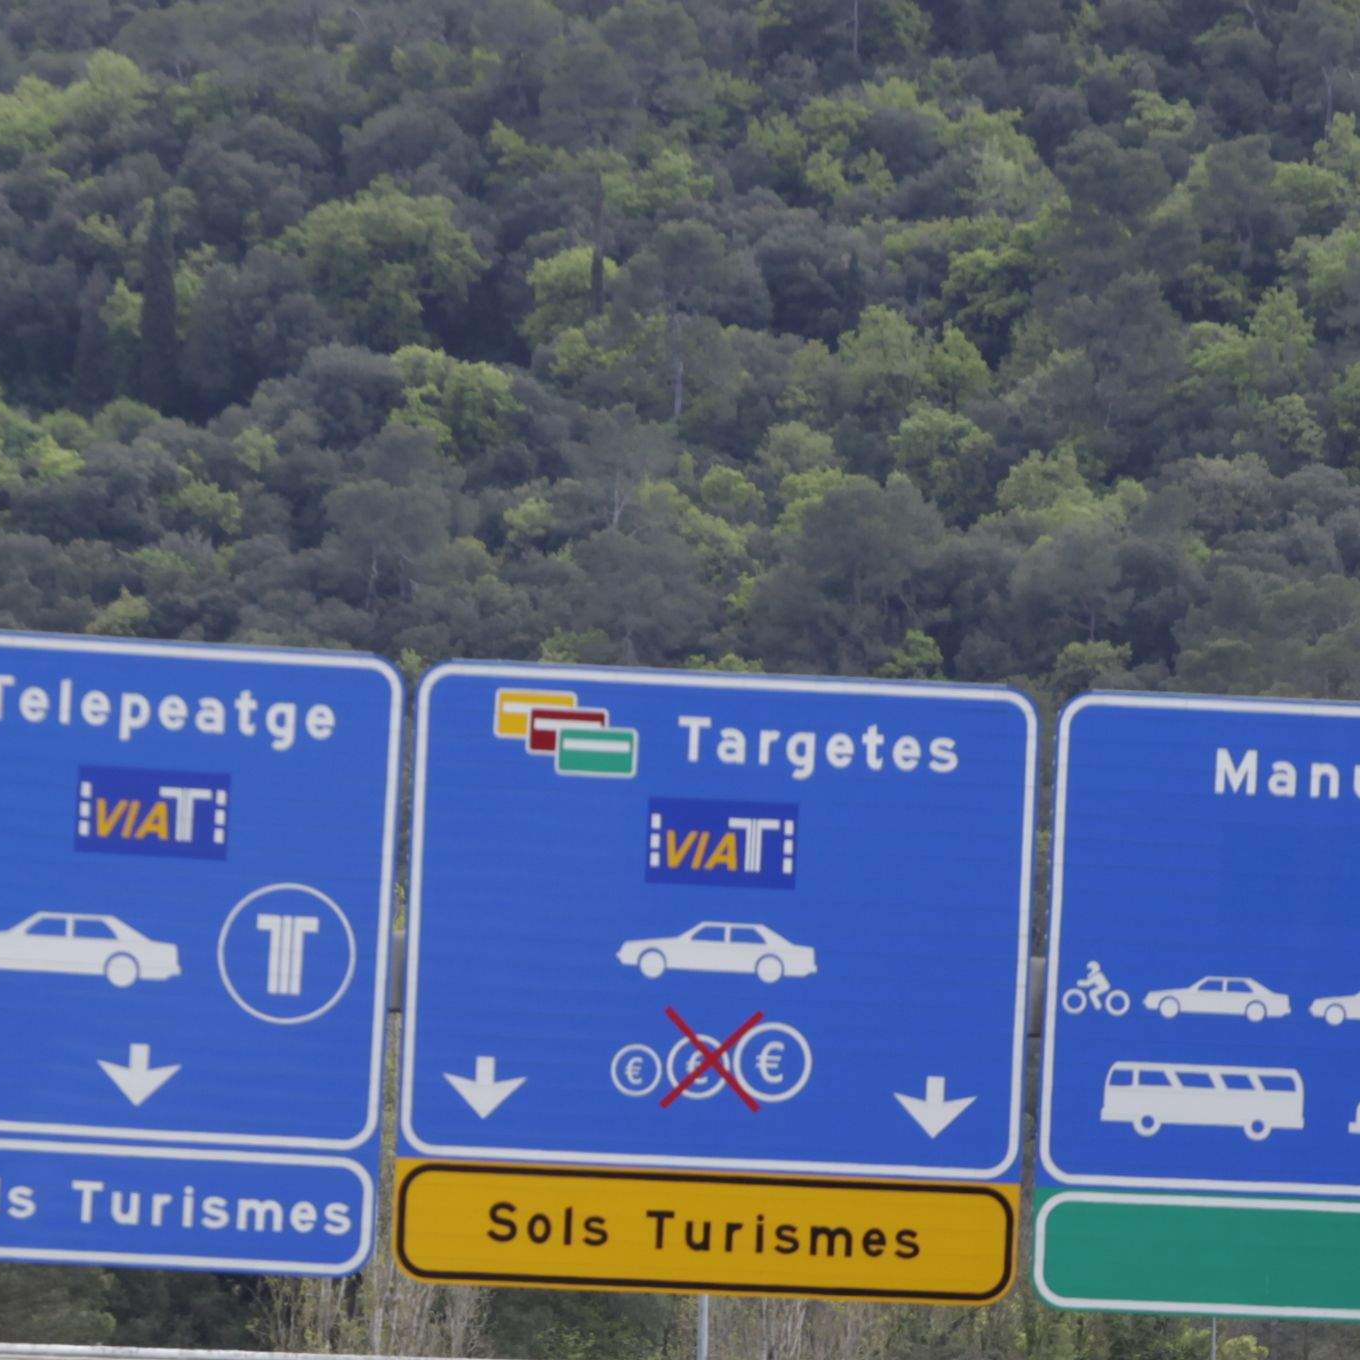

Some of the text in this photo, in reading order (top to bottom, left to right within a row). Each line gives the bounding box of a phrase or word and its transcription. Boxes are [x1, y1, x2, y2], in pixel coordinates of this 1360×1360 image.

[678, 715, 959, 780] Targetes
[71, 1180, 352, 1236] Turismes
[488, 1202, 921, 1260] Sols Turismes
